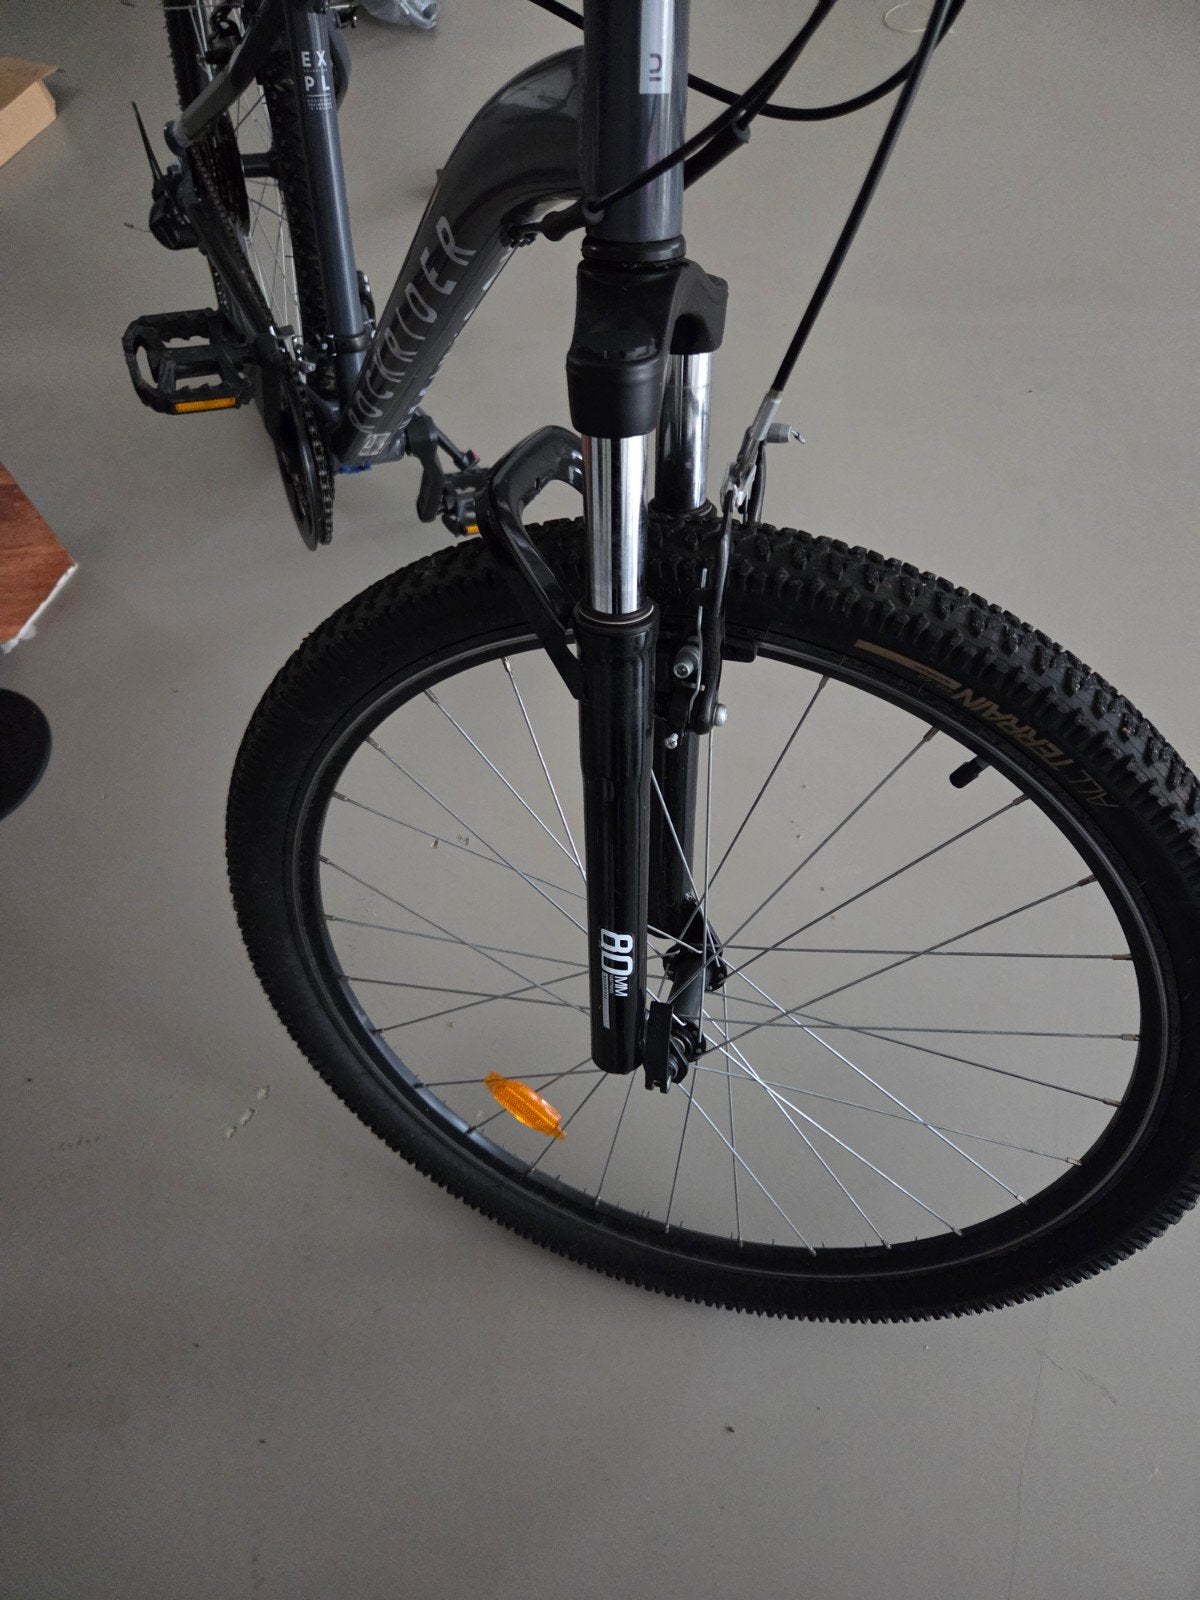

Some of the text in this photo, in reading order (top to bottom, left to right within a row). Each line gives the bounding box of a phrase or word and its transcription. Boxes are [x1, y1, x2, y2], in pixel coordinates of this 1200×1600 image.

[349, 215, 477, 434] ROCKRIDER
[951, 687, 1119, 808] ALL TERRAIN
